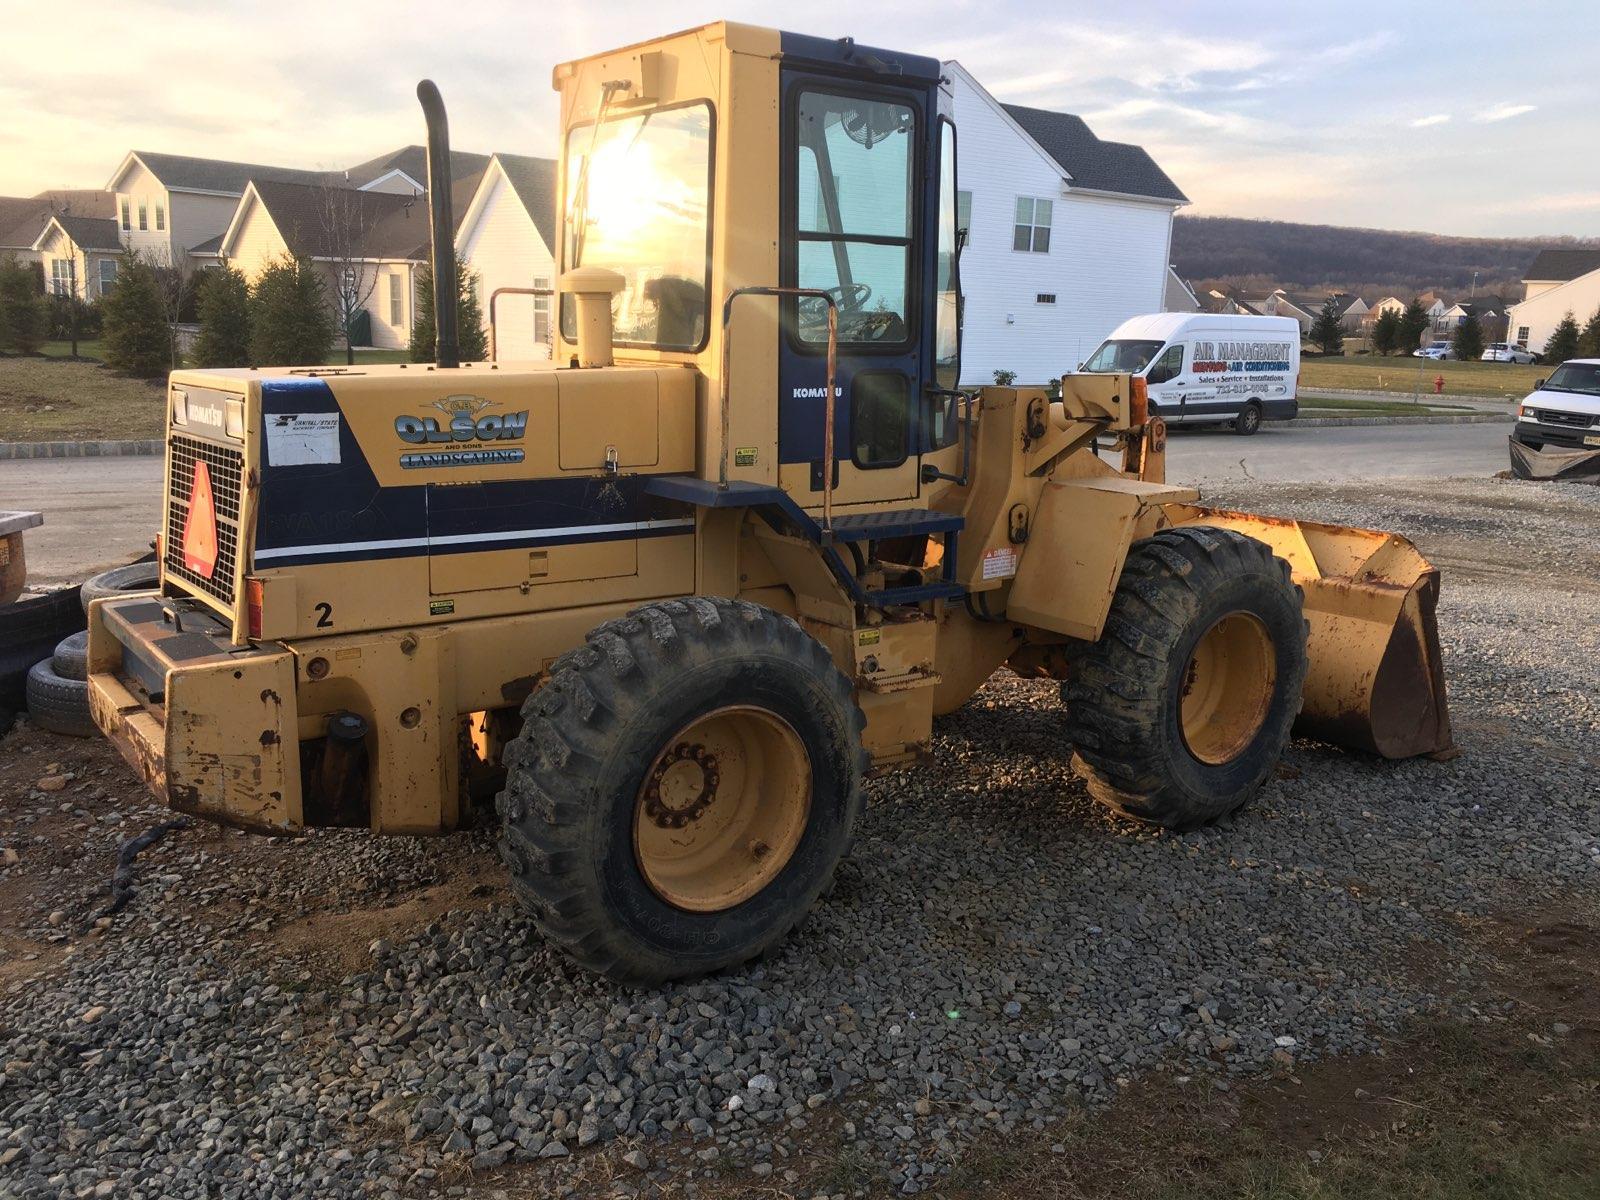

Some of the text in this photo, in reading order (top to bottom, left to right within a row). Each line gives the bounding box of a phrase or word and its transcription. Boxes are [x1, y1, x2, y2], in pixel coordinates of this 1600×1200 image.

[1193, 342, 1291, 361] AIR MANAGEMENT
[1231, 361, 1243, 371] AIR
[1244, 361, 1290, 371] CONDITIONING
[1198, 376, 1216, 384] Sales
[1249, 374, 1284, 382] Installations
[793, 387, 842, 398] KOMATU
[189, 403, 223, 427] KOMATSU
[394, 410, 530, 444] OLSON
[407, 450, 519, 467] LANDSCAPING
[314, 602, 334, 628] 2
